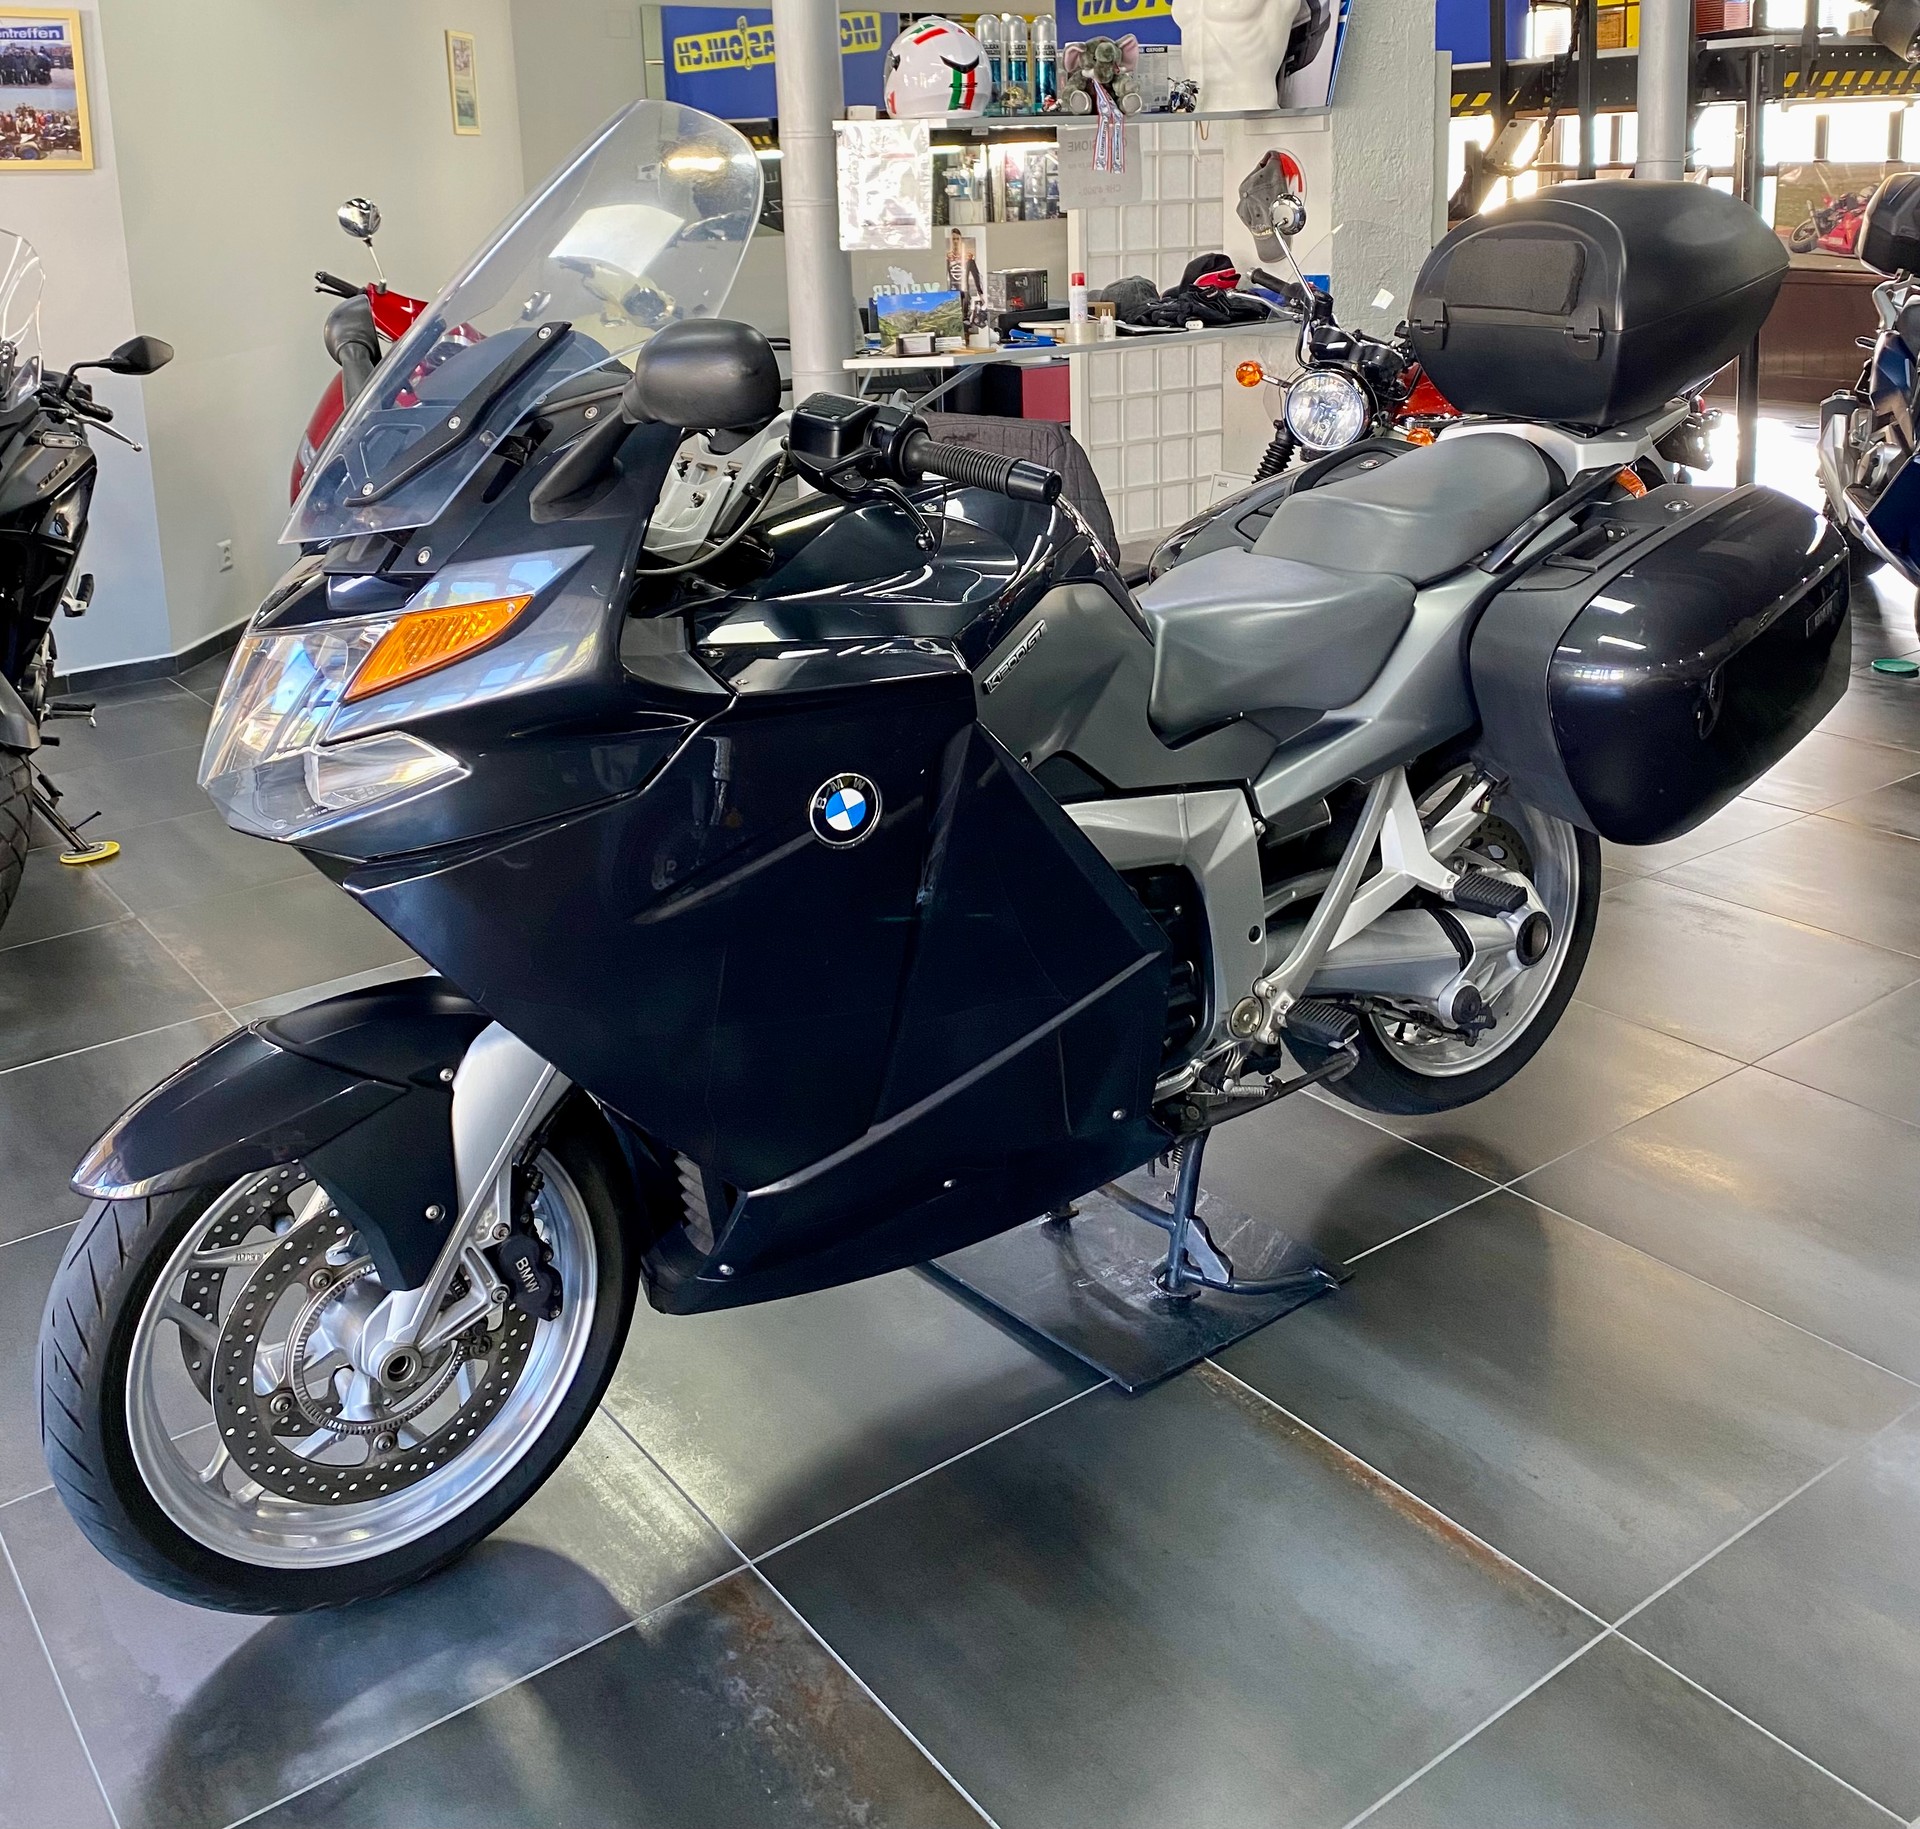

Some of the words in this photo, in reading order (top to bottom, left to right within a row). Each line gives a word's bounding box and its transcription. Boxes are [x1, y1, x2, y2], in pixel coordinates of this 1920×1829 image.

[0, 26, 60, 39] ntreffen
[815, 777, 866, 810] BMW
[515, 1256, 540, 1293] BMW
